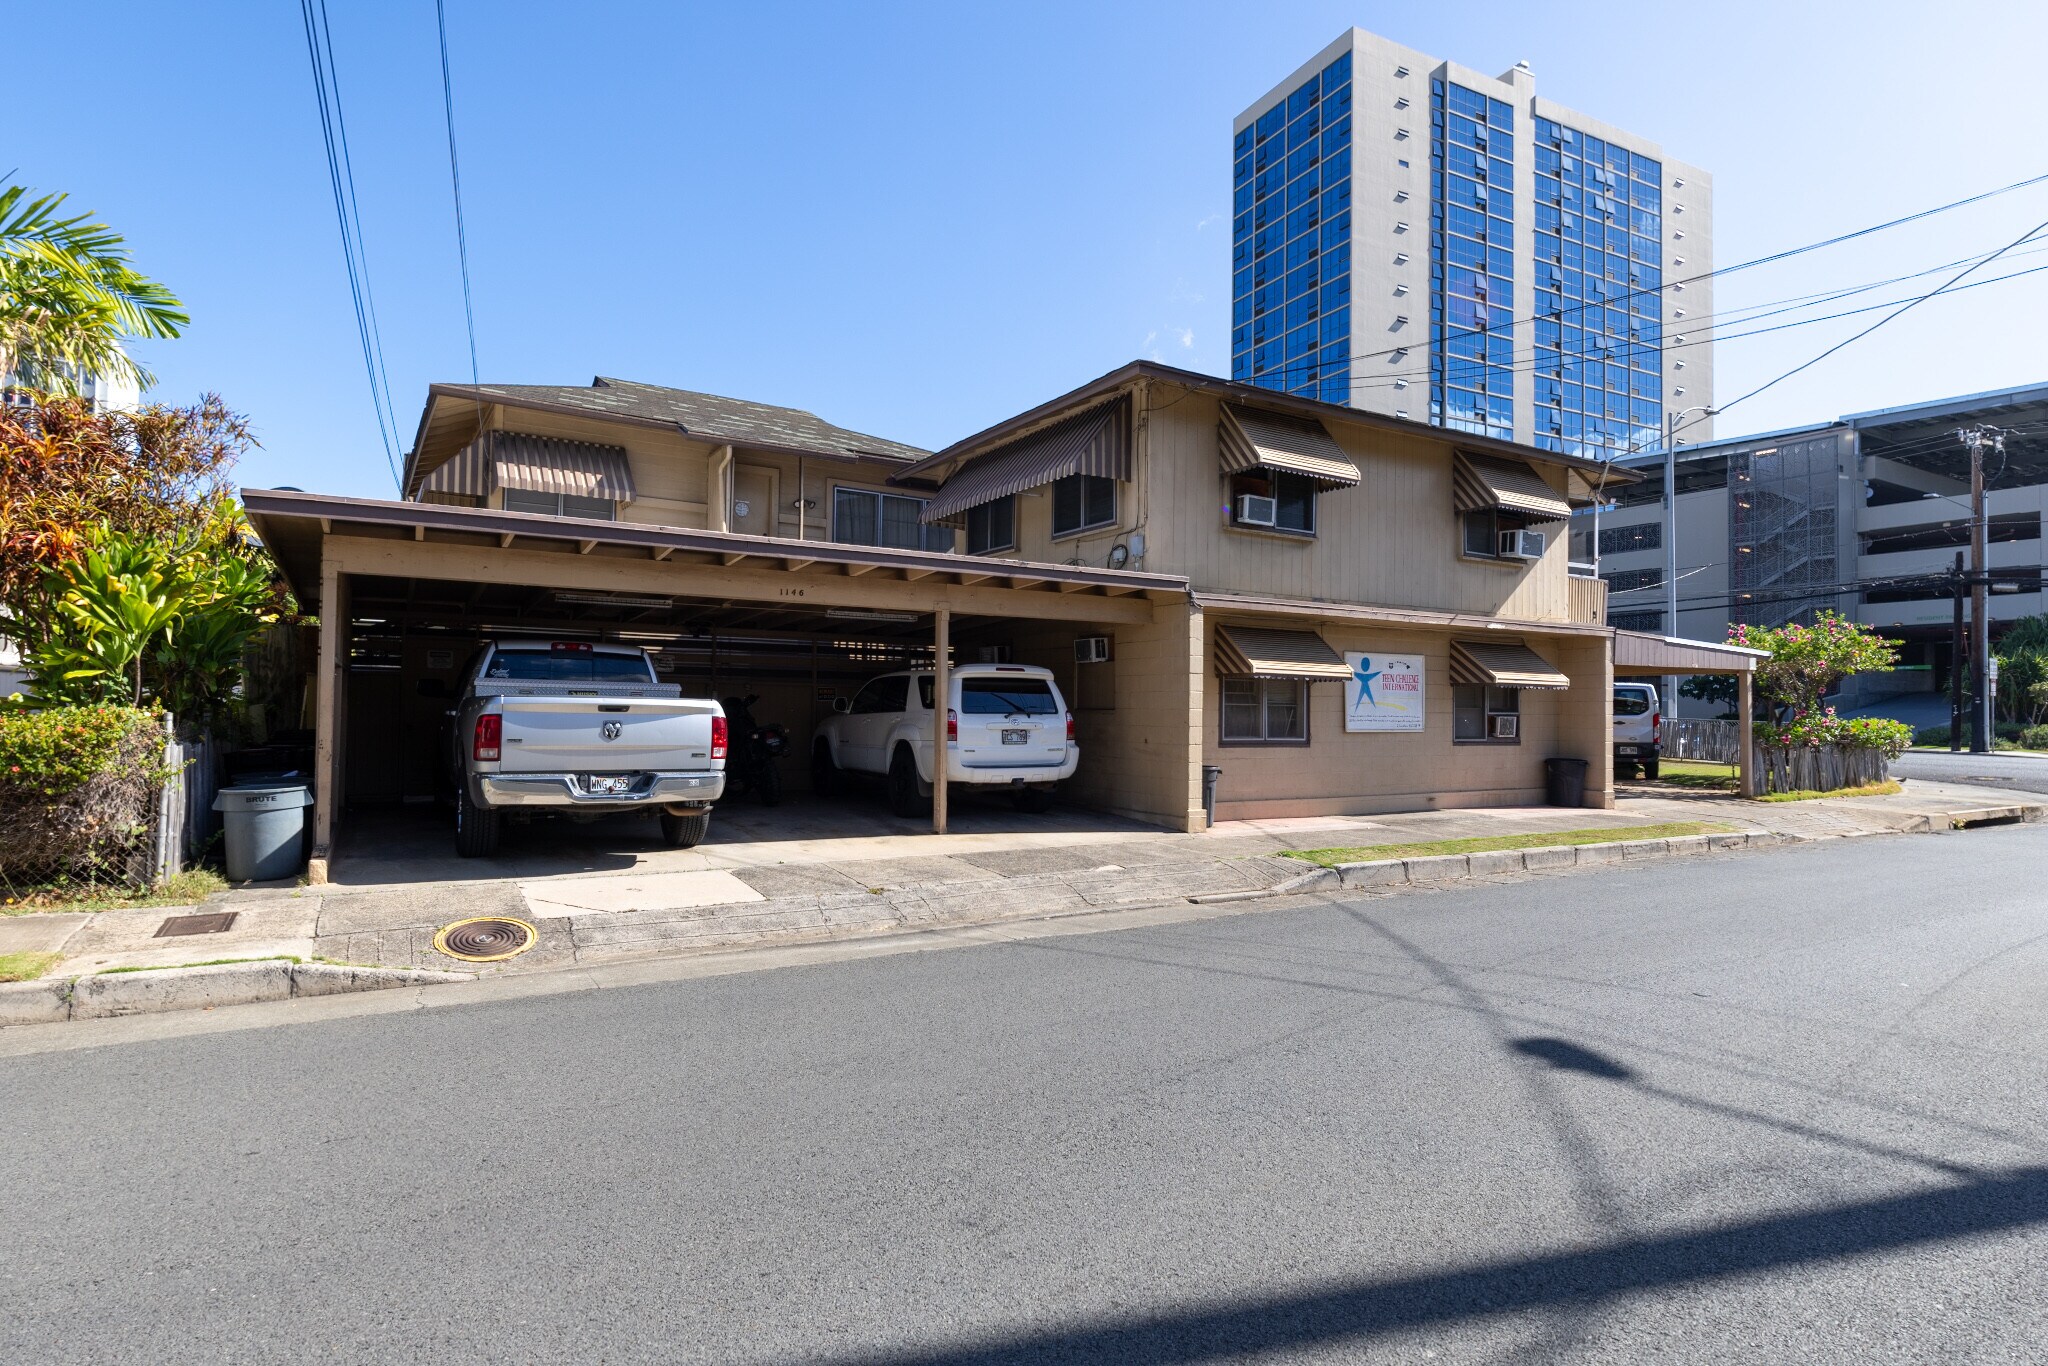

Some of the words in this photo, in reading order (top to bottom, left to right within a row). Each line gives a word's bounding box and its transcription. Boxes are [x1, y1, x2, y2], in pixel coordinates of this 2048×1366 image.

[1382, 673, 1395, 683] TEEN
[1382, 683, 1419, 692] INTERNATIONAL
[612, 778, 629, 789] 455
[245, 795, 277, 803] BRUTE
